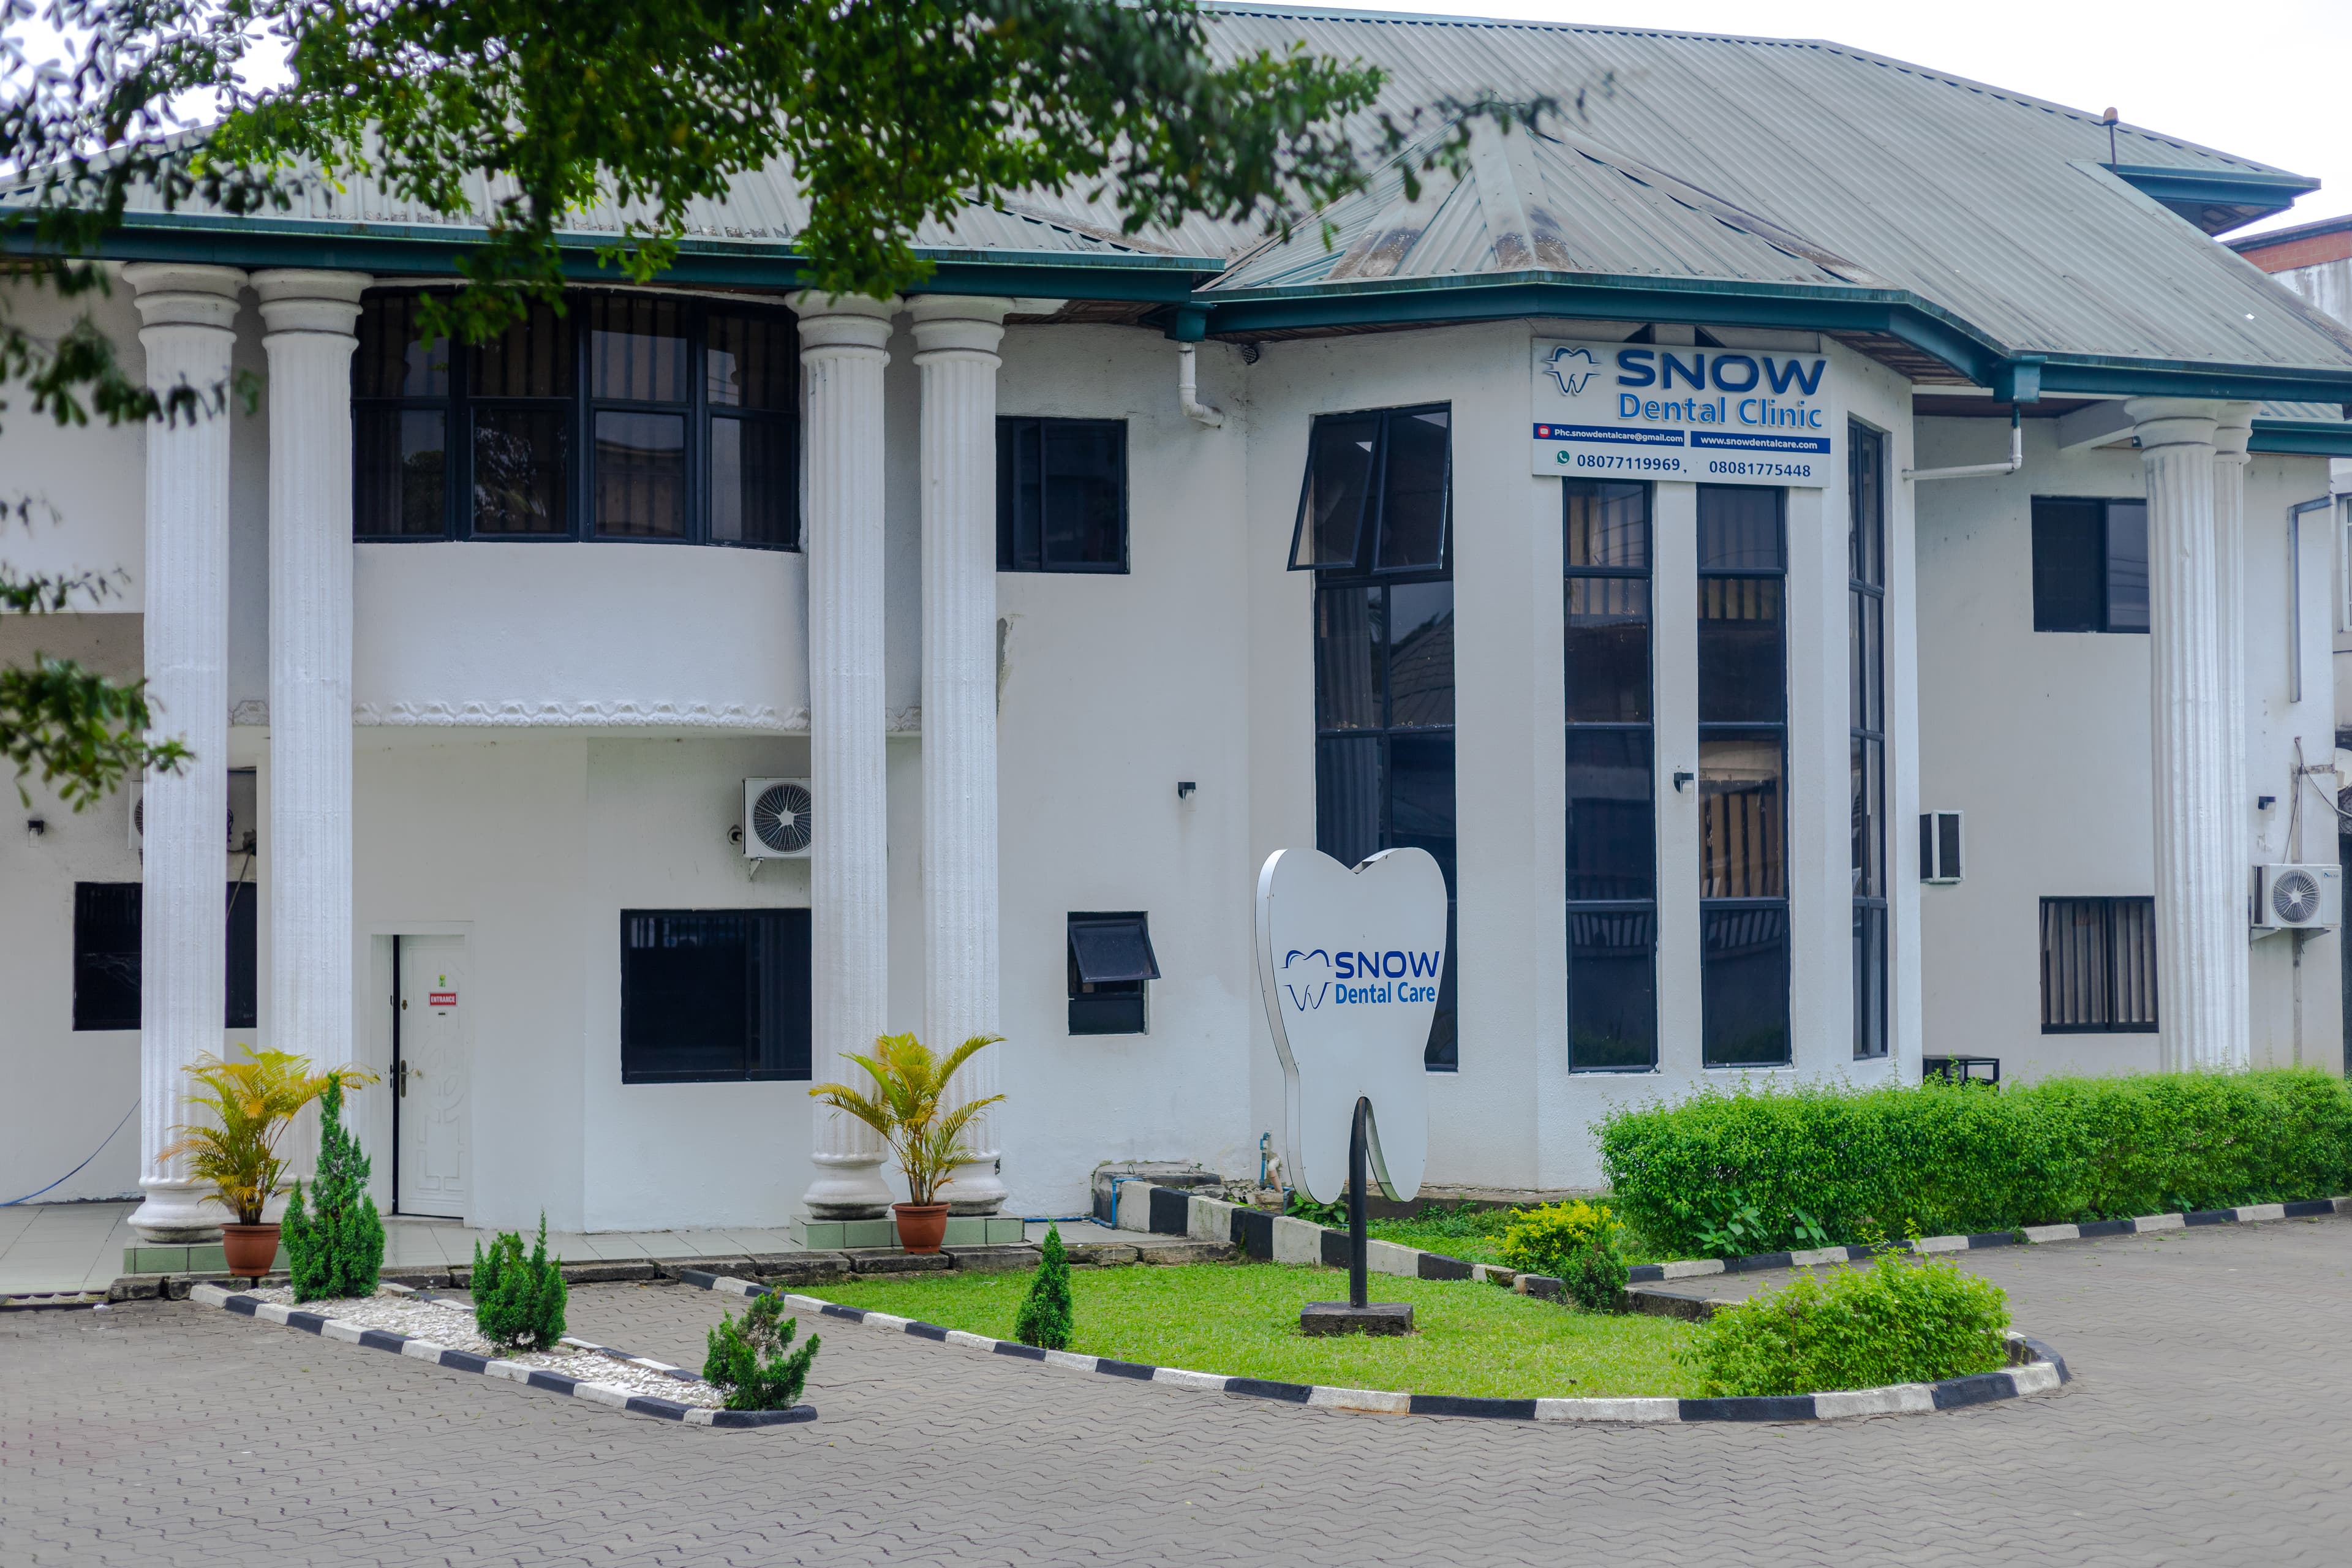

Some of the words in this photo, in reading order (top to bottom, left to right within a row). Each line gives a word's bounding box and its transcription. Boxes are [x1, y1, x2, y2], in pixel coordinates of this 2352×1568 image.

[1618, 349, 1826, 395] SNOW
[1619, 393, 1725, 423] Dental
[1738, 398, 1822, 428] Clinic
[1554, 428, 1684, 443] Phc.snowdentalcare@gmail.com
[1700, 435, 1818, 450] www.snowdentalcare.com
[1709, 461, 1811, 477] 08081775448
[1335, 951, 1440, 979] SNOW
[1336, 981, 1392, 1004] Dental
[1398, 981, 1436, 1003] Care
